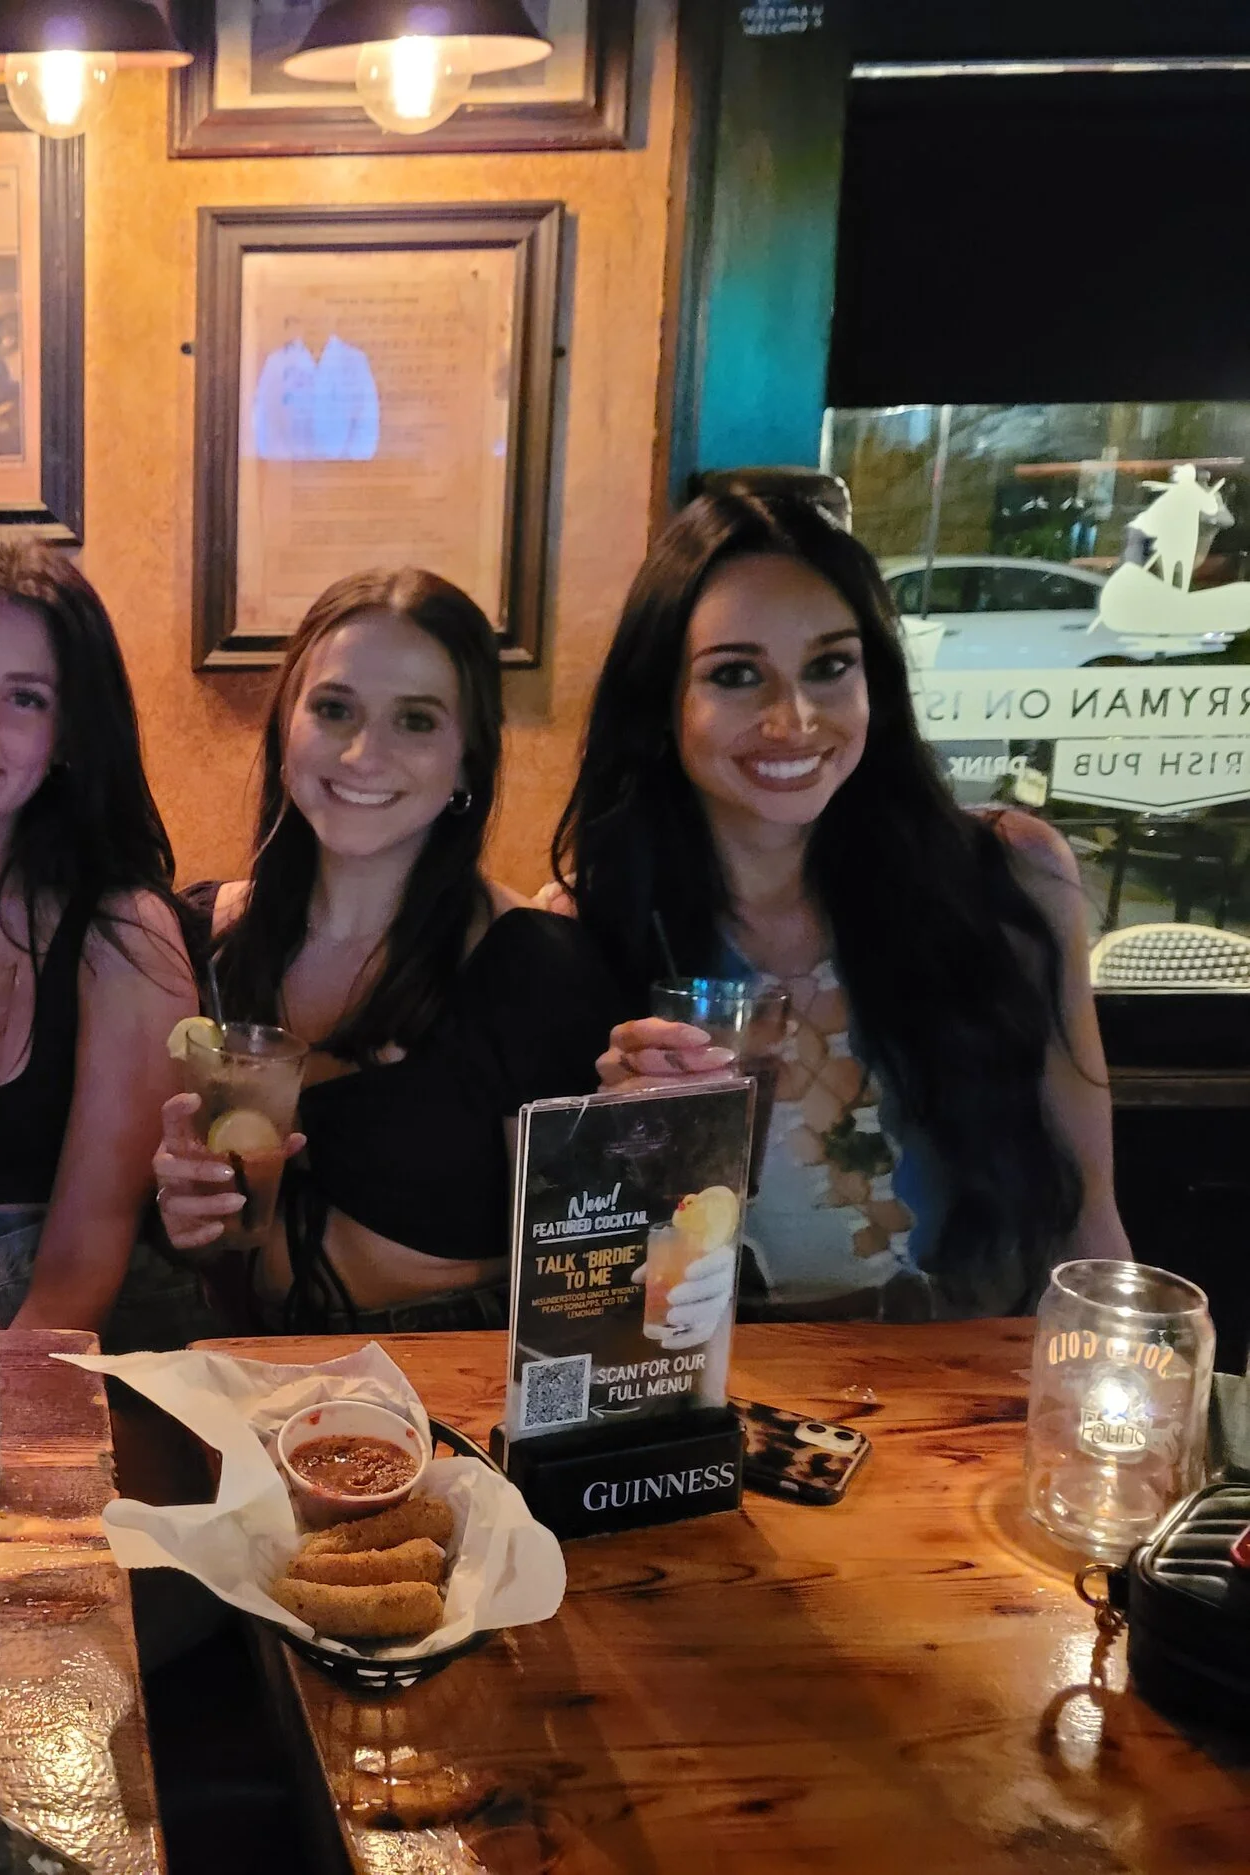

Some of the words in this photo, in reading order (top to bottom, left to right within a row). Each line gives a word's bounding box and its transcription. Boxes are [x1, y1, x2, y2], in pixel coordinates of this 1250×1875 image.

[568, 1182, 622, 1219] New!
[532, 1218, 592, 1238] FEATURED
[594, 1210, 649, 1230] COCKTAIL
[535, 1253, 576, 1275] TALK
[565, 1271, 585, 1290] TO
[588, 1267, 612, 1287] ME
[541, 1304, 563, 1314] PEACH
[601, 1297, 616, 1306] ICED
[586, 1289, 610, 1299] GINGER
[596, 1363, 638, 1385] SCAN
[640, 1358, 671, 1378] FOR
[673, 1353, 707, 1374] OUR
[607, 1383, 644, 1403] FULL
[646, 1375, 694, 1397] MENU!
[583, 1462, 736, 1512] GUINNESS
